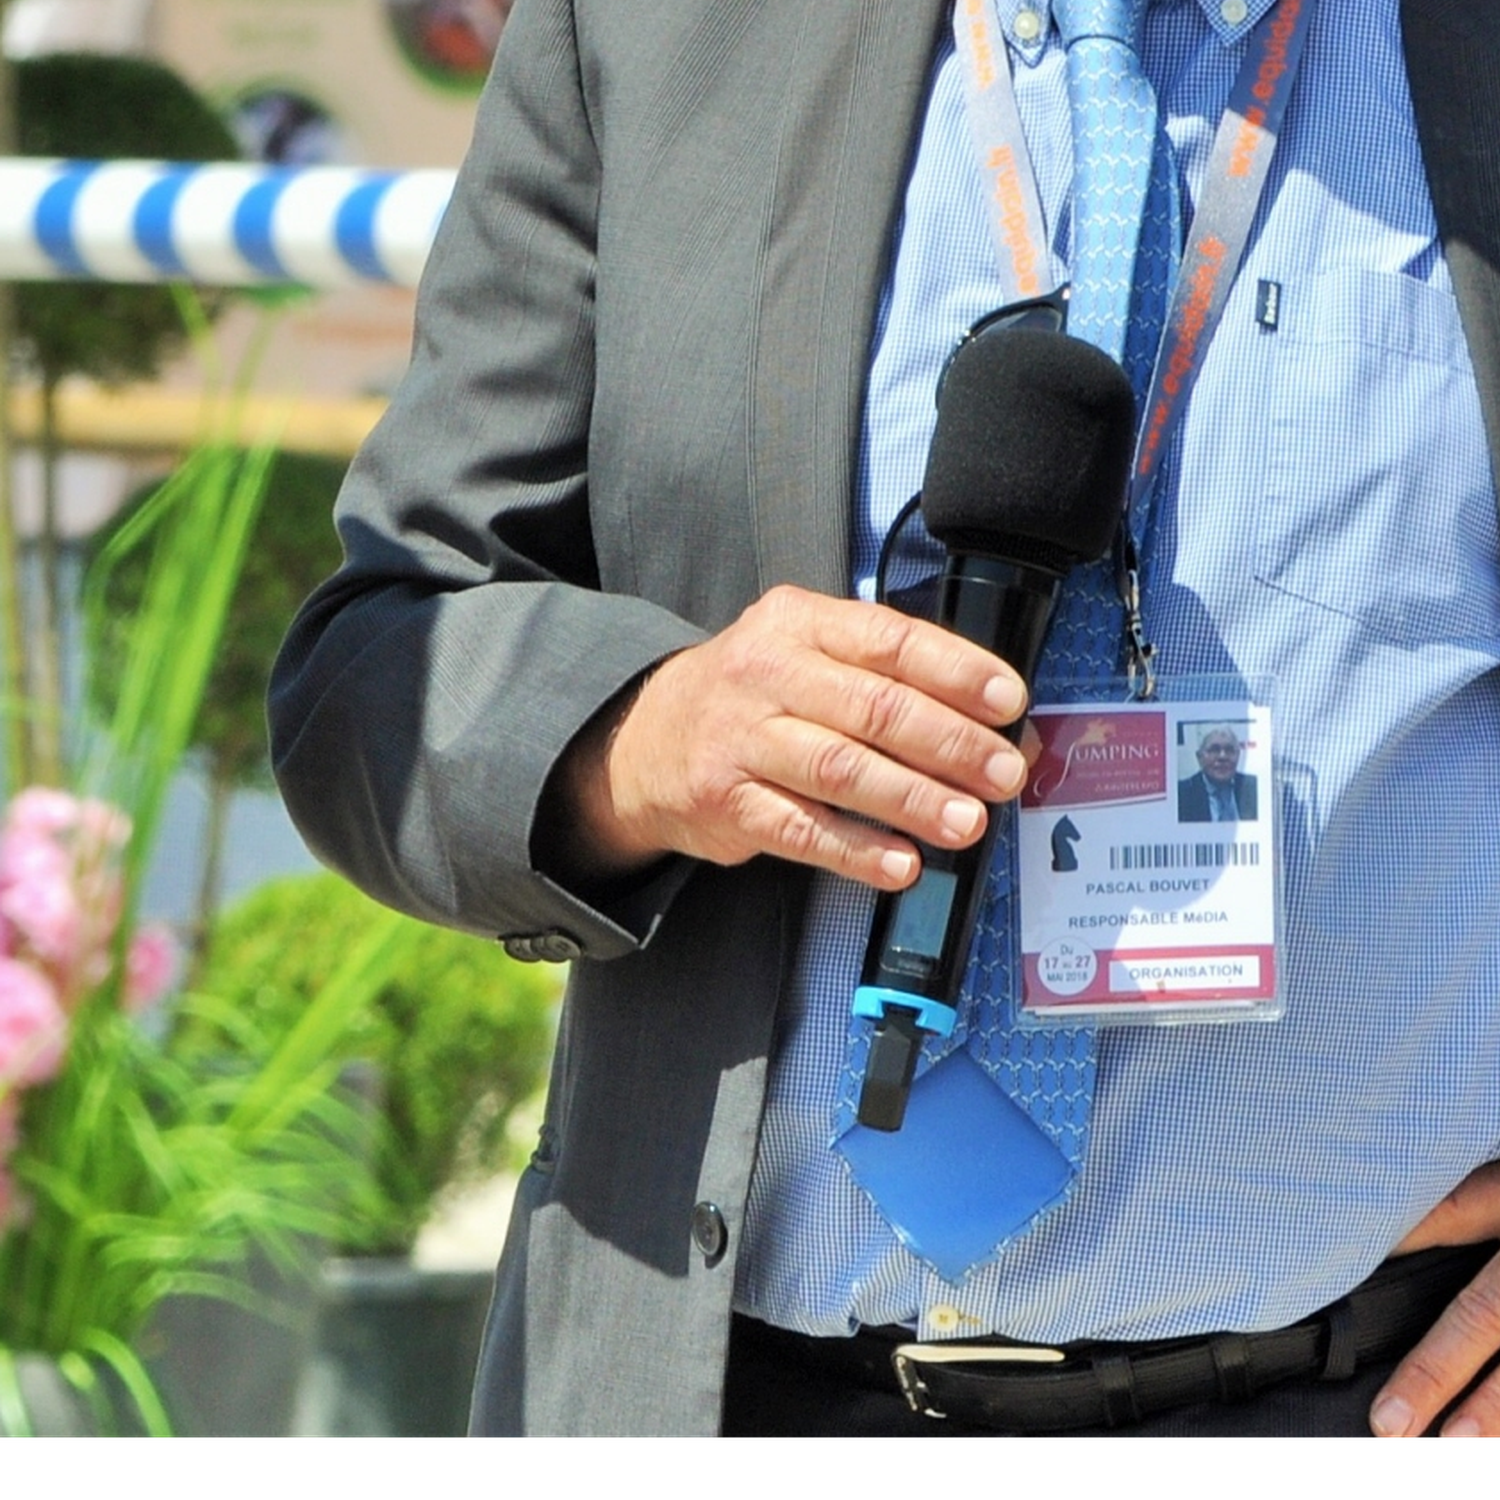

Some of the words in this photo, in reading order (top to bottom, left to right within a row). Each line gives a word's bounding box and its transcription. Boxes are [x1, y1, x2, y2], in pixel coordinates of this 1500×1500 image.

[1033, 741, 1160, 798] JUMPING
[1085, 882, 1145, 896] PASCAL
[1149, 878, 1211, 892] BOUVET
[1068, 912, 1179, 929] RESPONSABLE
[1044, 957, 1060, 969] 17
[1075, 955, 1092, 968] 27
[1046, 971, 1064, 982] MAI
[1065, 970, 1089, 982] 2018
[1128, 964, 1244, 981] ORGANISATION
